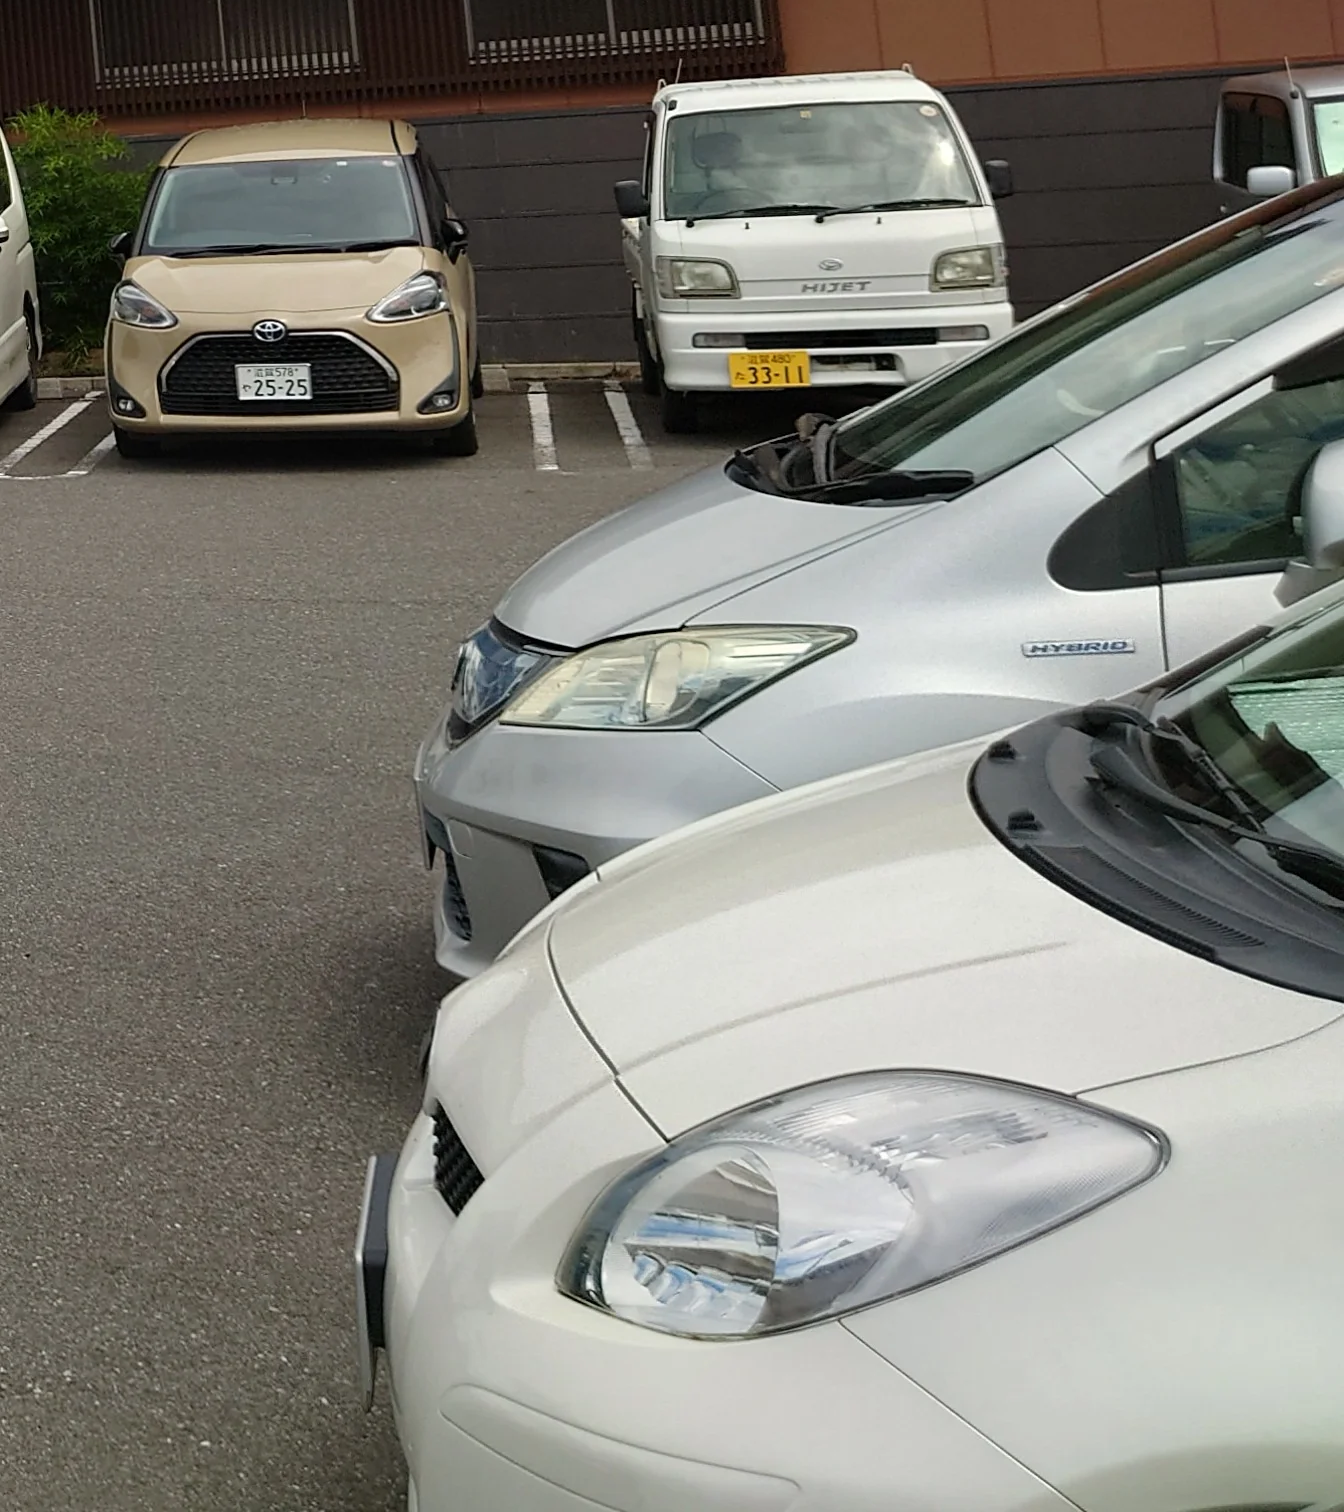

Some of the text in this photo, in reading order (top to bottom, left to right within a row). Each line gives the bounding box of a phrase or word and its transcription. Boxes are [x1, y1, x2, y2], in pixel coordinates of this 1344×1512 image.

[801, 281, 872, 293] HIJET
[748, 365, 804, 384] 33-11
[254, 379, 308, 397] 25-25
[1030, 641, 1127, 653] HYBRID
